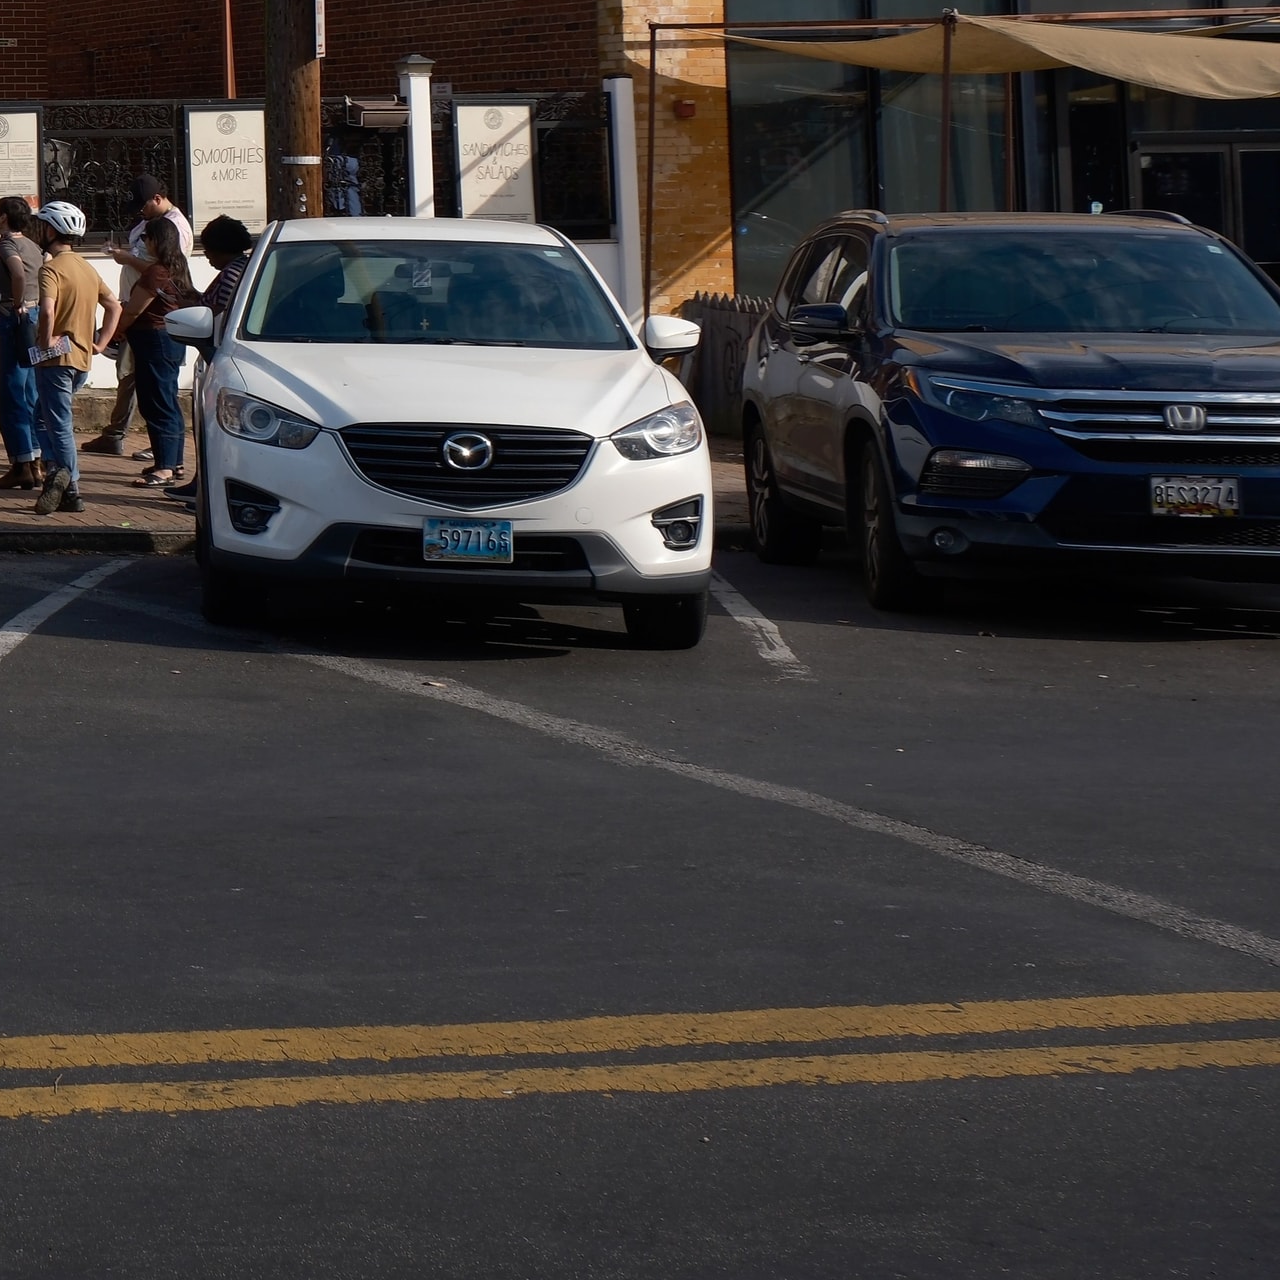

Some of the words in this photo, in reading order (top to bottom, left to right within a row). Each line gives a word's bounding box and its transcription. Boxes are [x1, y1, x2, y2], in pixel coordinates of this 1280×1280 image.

[192, 146, 265, 167] SMOOTHIES
[462, 142, 529, 157] SANDWICHES
[211, 171, 218, 181] &
[219, 168, 248, 182] MORE
[477, 165, 520, 180] SALADS
[440, 528, 497, 551] 59716
